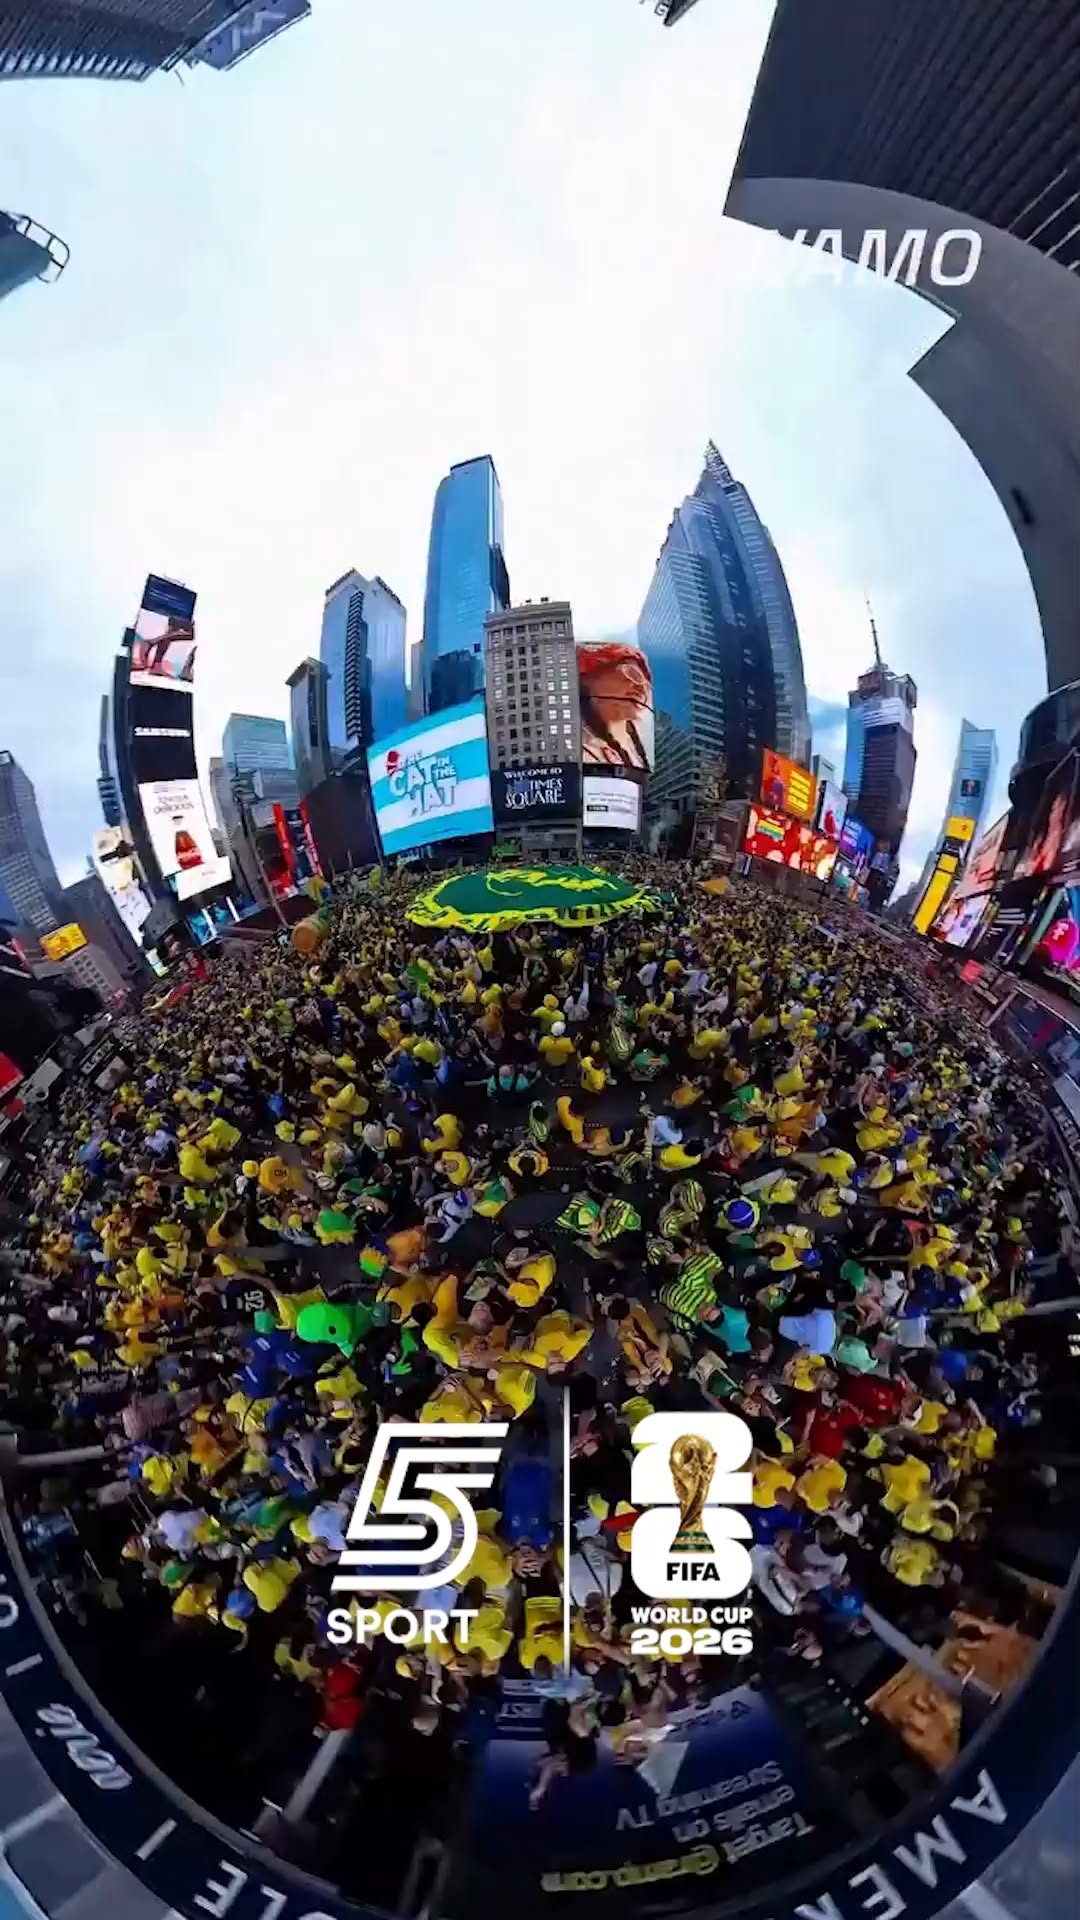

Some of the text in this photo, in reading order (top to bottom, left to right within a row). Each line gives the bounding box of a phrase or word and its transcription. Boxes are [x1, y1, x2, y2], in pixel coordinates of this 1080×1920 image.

[390, 757, 437, 797] CAT
[505, 788, 566, 810] SQUARE
[616, 1760, 783, 1831] Streaming TV
[672, 1785, 796, 1843] emails on
[721, 1812, 816, 1863] Target
